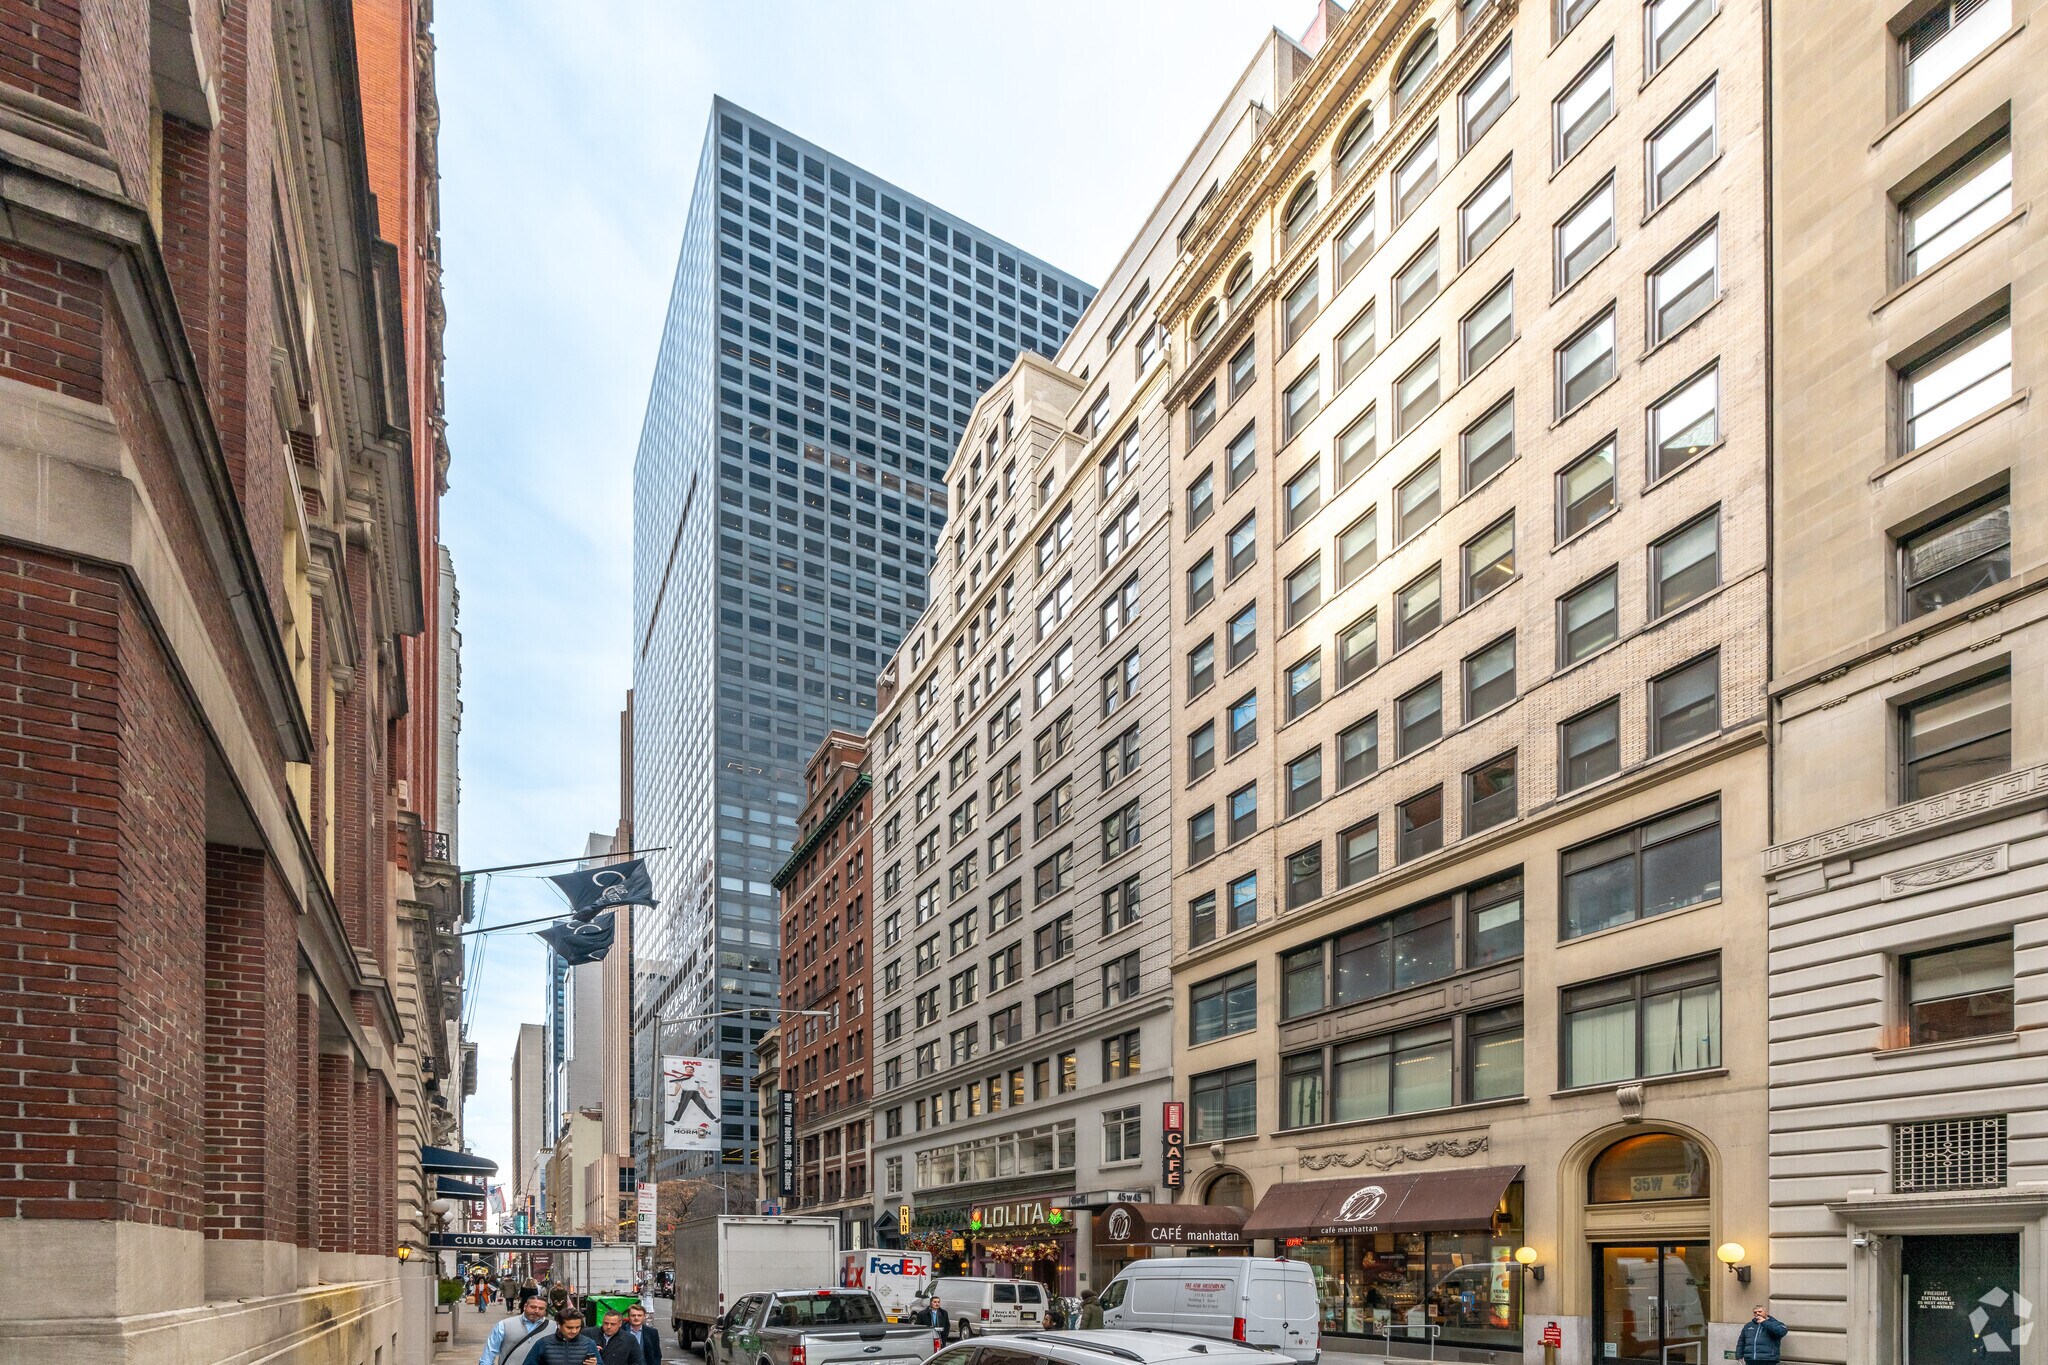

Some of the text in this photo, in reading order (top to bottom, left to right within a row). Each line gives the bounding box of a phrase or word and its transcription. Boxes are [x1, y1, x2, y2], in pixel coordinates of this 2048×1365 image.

[1166, 1133, 1181, 1185] CAFÉ
[1632, 1175, 1689, 1192] 35W 45
[984, 1202, 1045, 1228] LOLITA
[455, 1237, 577, 1247] CLUB QUARTERS HOTEL
[1151, 1225, 1239, 1241] CAFÉ manhattan
[840, 1256, 864, 1288] dEx
[870, 1257, 928, 1276] FedEx
